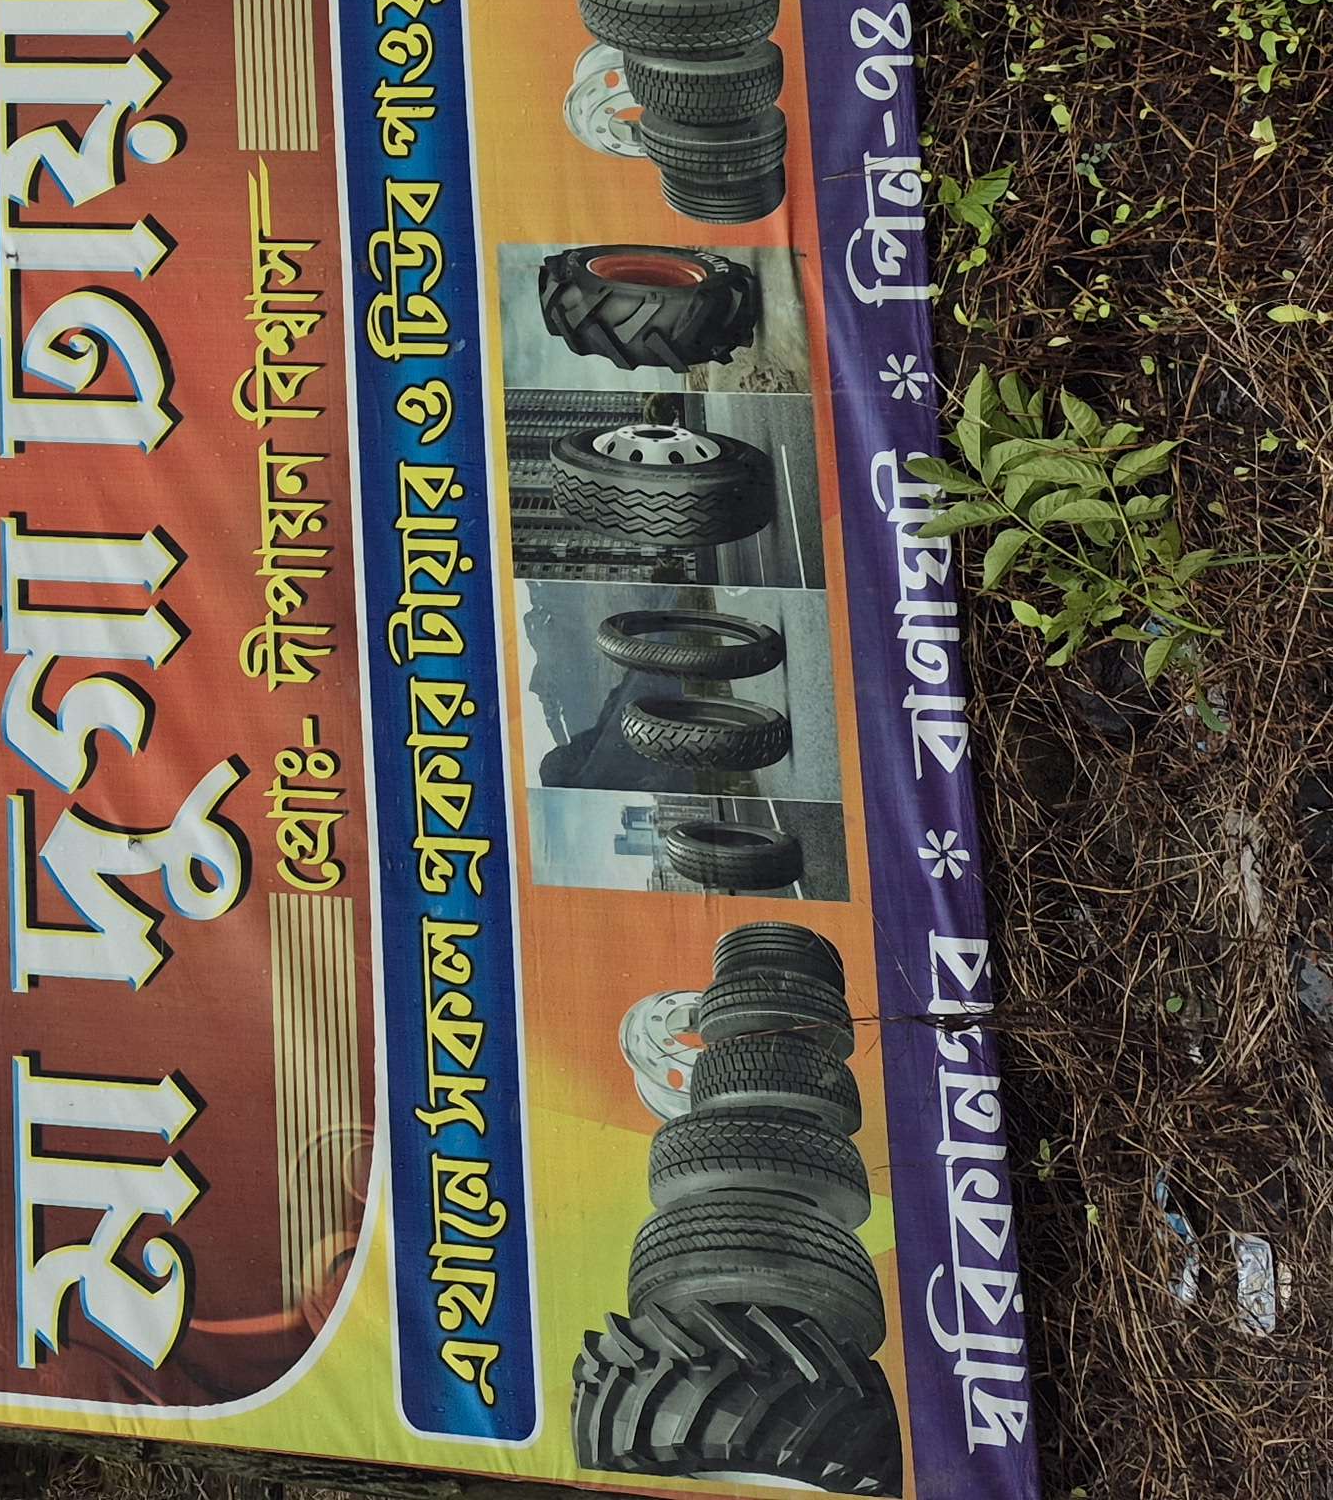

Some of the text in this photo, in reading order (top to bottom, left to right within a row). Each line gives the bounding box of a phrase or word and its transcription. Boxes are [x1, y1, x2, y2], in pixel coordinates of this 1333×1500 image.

[364, 179, 451, 361] টিউব
[395, 379, 453, 443] ও
[239, 440, 333, 692] দীপায়ন
[386, 461, 474, 666] টায়ার
[407, 677, 491, 896] প্রকার
[415, 917, 490, 1137] সকল
[11, 1052, 203, 1370] মা
[427, 1150, 507, 1407] এখানে
